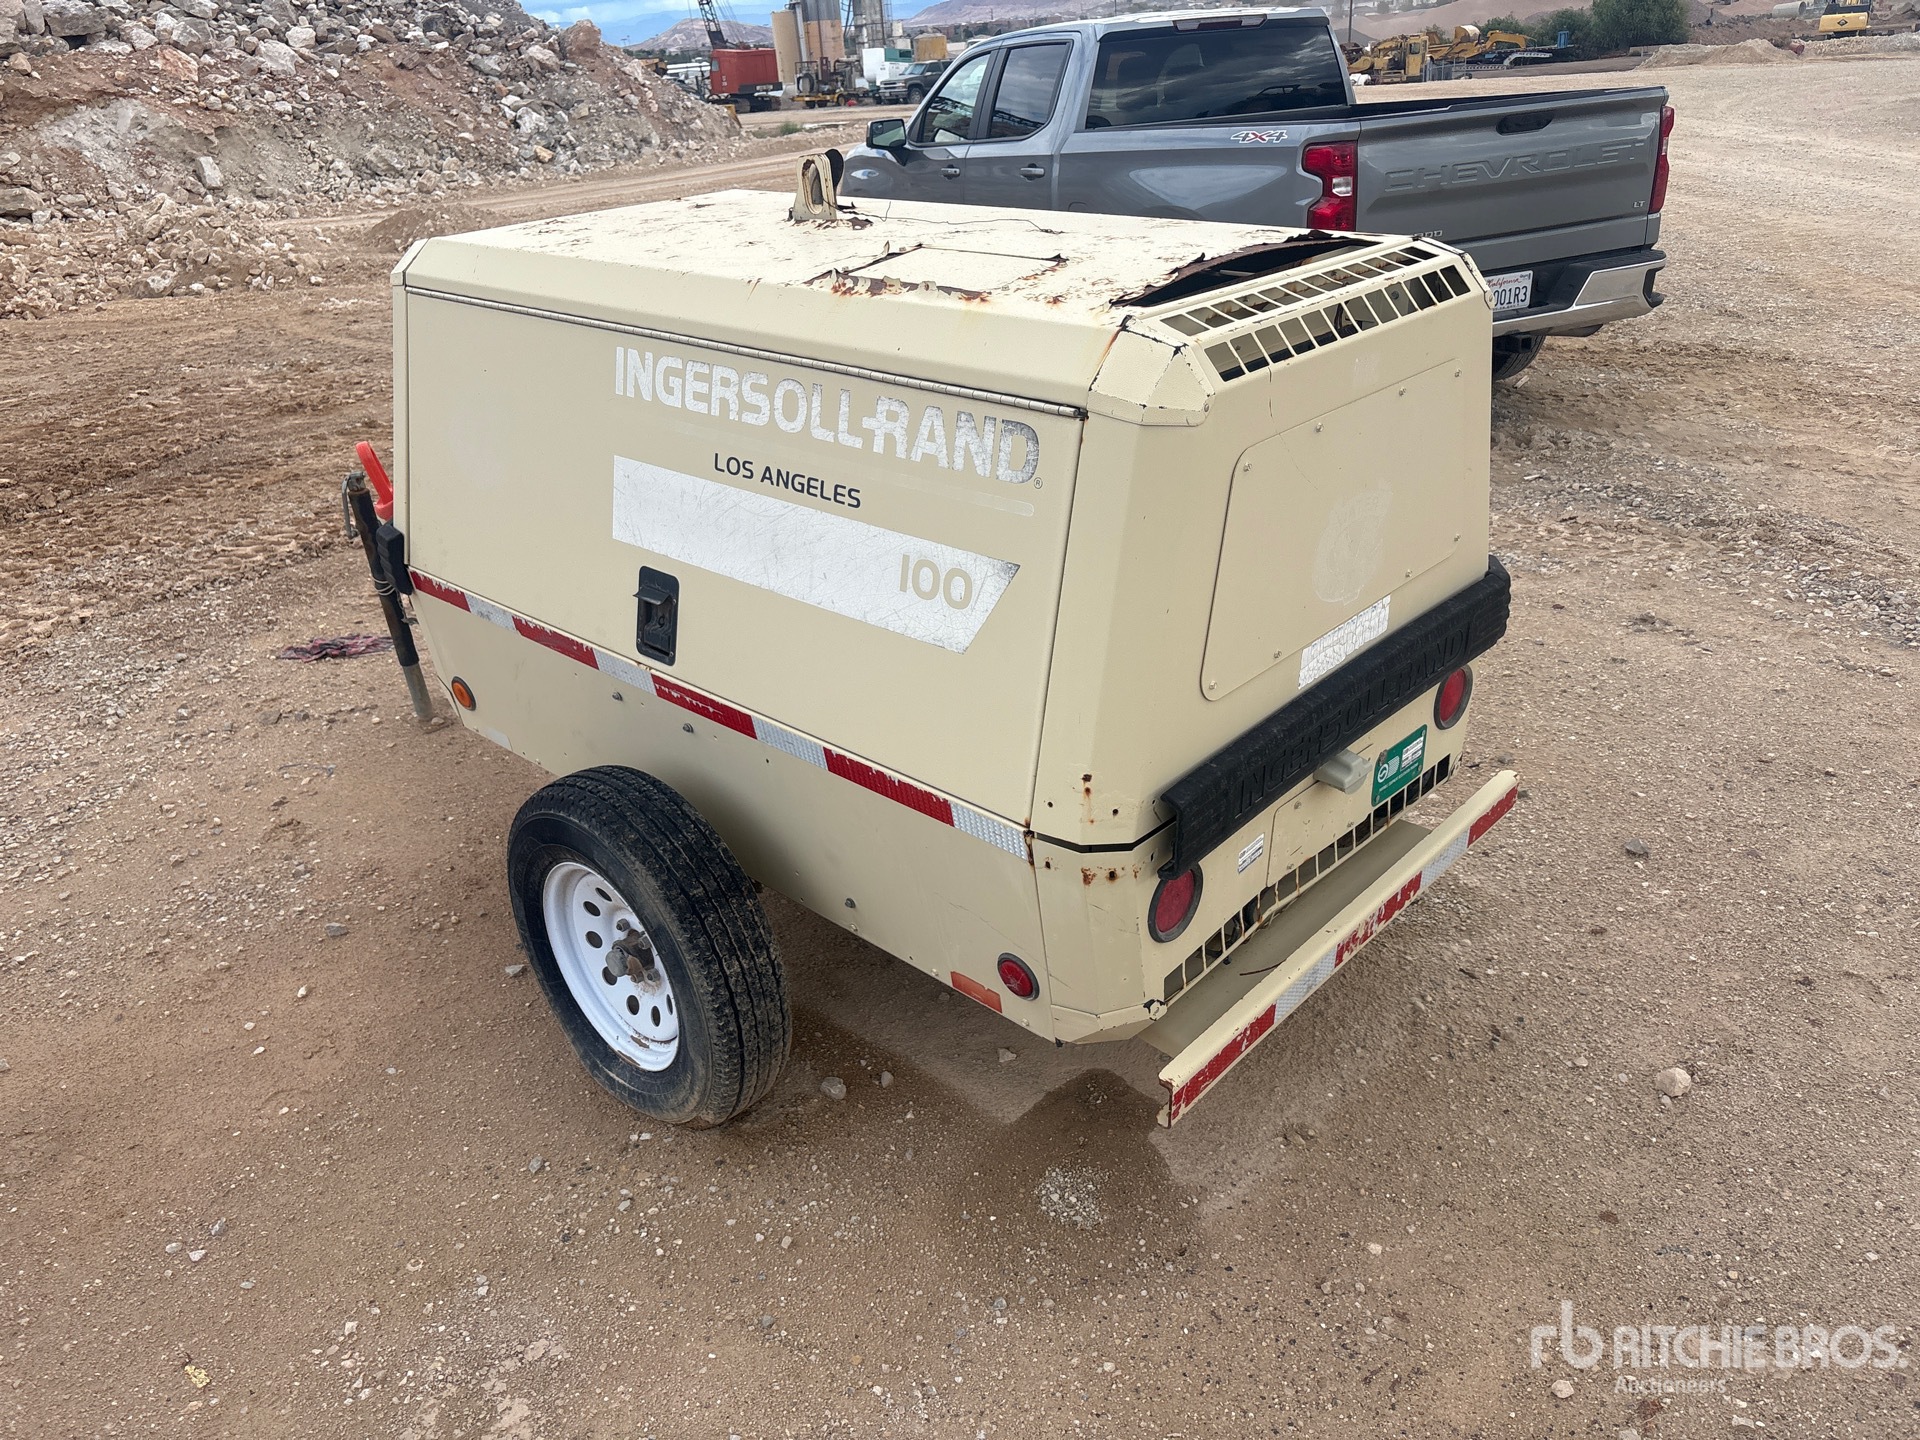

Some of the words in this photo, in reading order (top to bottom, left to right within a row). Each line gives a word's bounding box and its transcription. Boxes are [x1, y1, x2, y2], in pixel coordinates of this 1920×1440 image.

[1384, 143, 1645, 192] CHEVROLET
[614, 346, 1040, 485] INGERSOLL-RAND
[713, 452, 754, 480] LOS
[759, 465, 862, 510] ANGELES
[899, 553, 974, 611] 100
